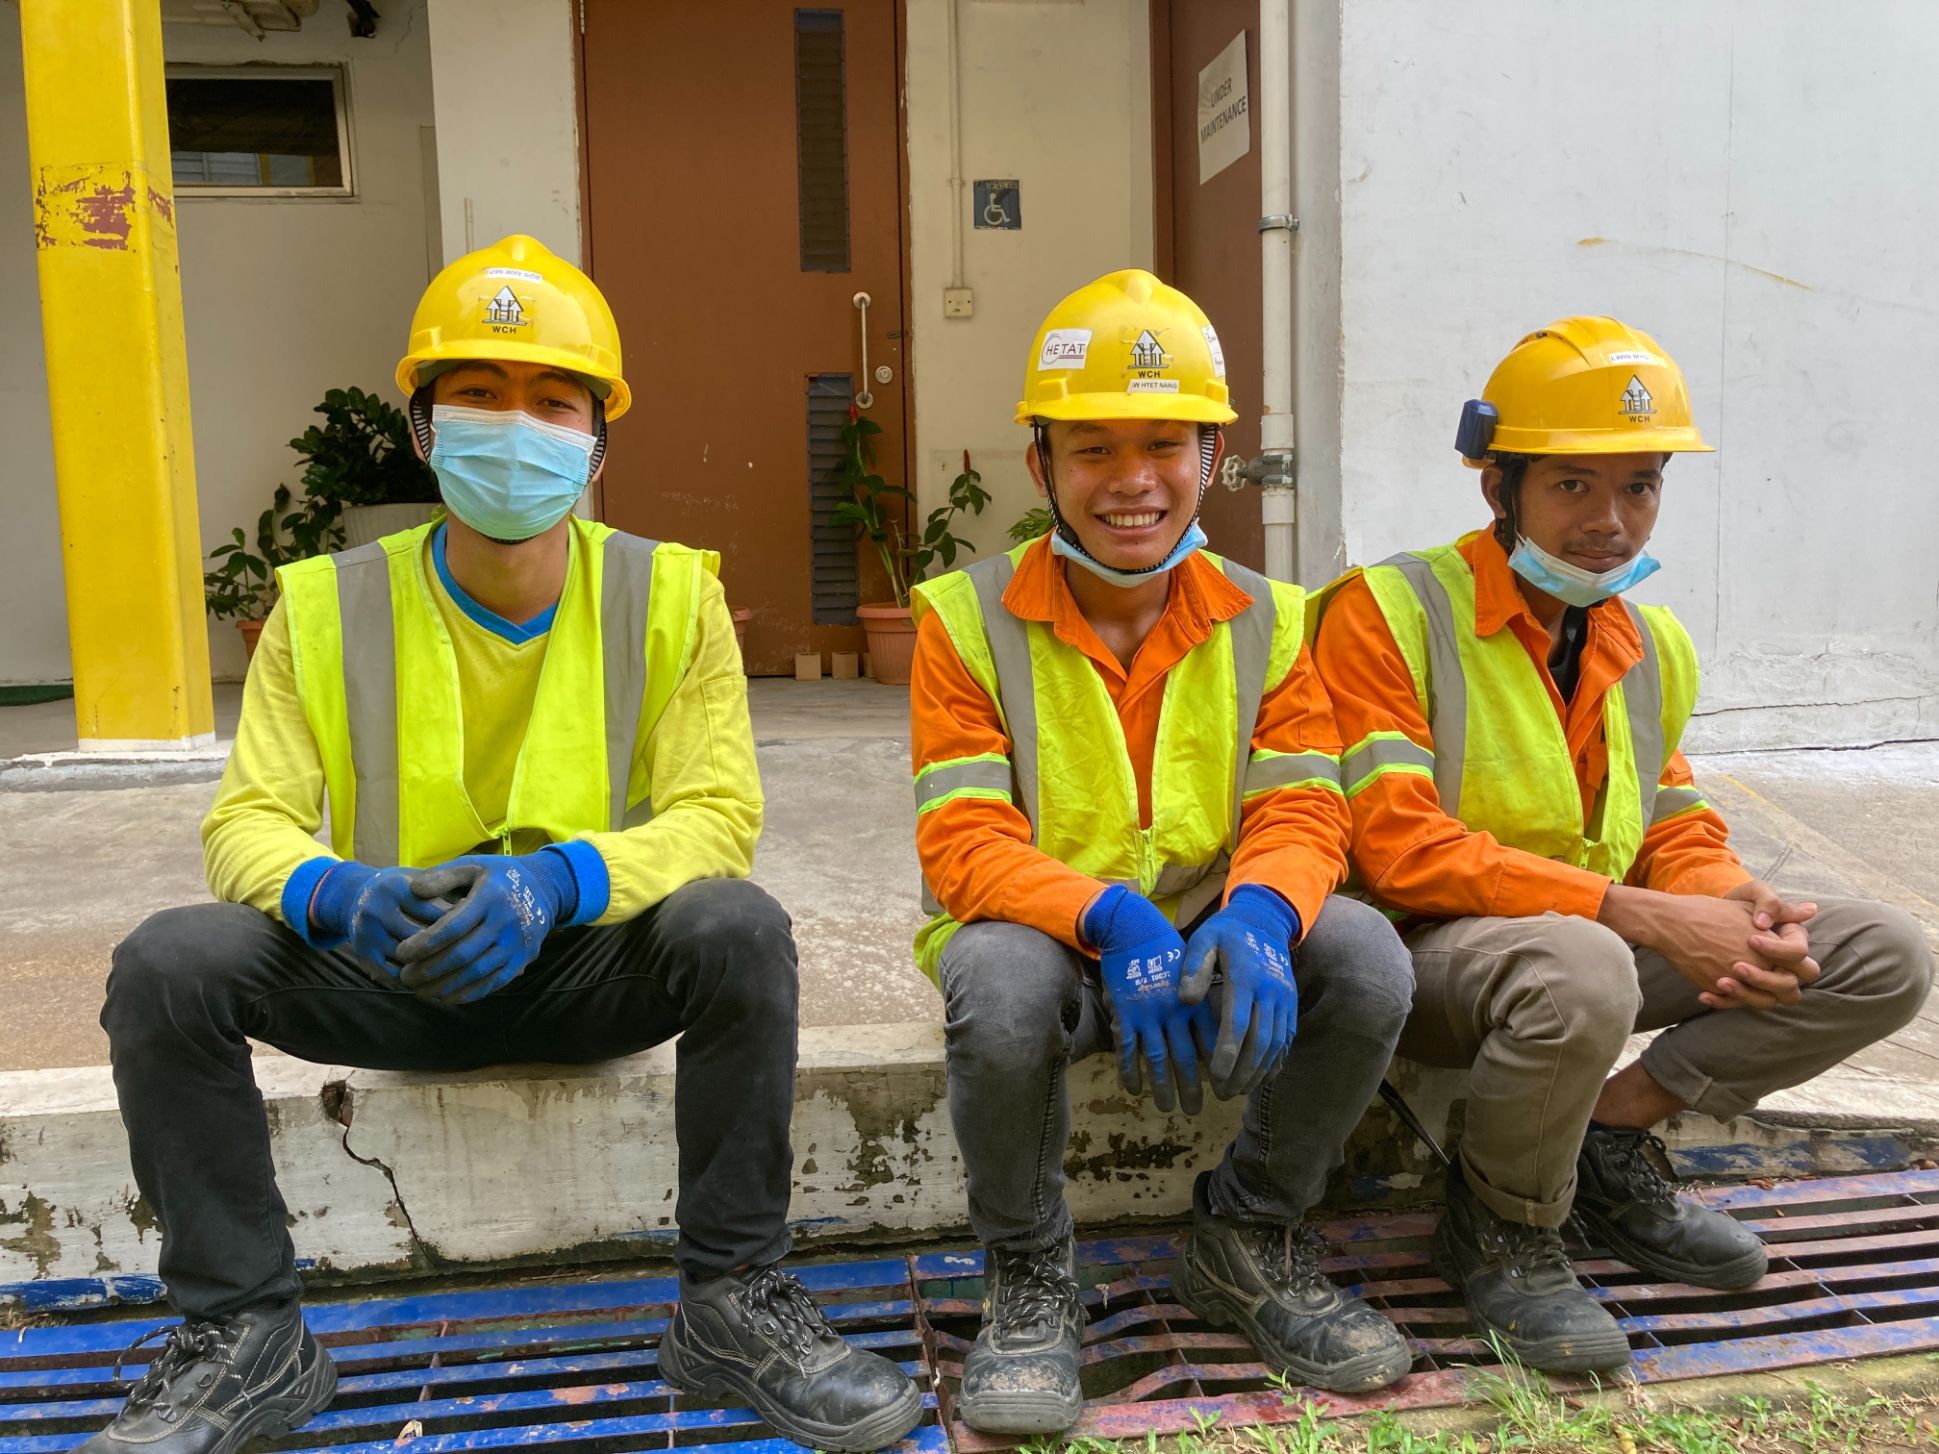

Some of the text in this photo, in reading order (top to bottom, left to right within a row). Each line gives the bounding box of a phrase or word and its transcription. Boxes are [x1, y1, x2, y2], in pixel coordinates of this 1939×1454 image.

[1211, 77, 1232, 108] UNDER
[1200, 95, 1247, 145] MAINTENANCE
[492, 325, 517, 334] WCH
[1045, 343, 1086, 356] HETAT
[1137, 370, 1161, 379] WCH
[1628, 415, 1651, 423] WCH
[1166, 948, 1181, 962] CE
